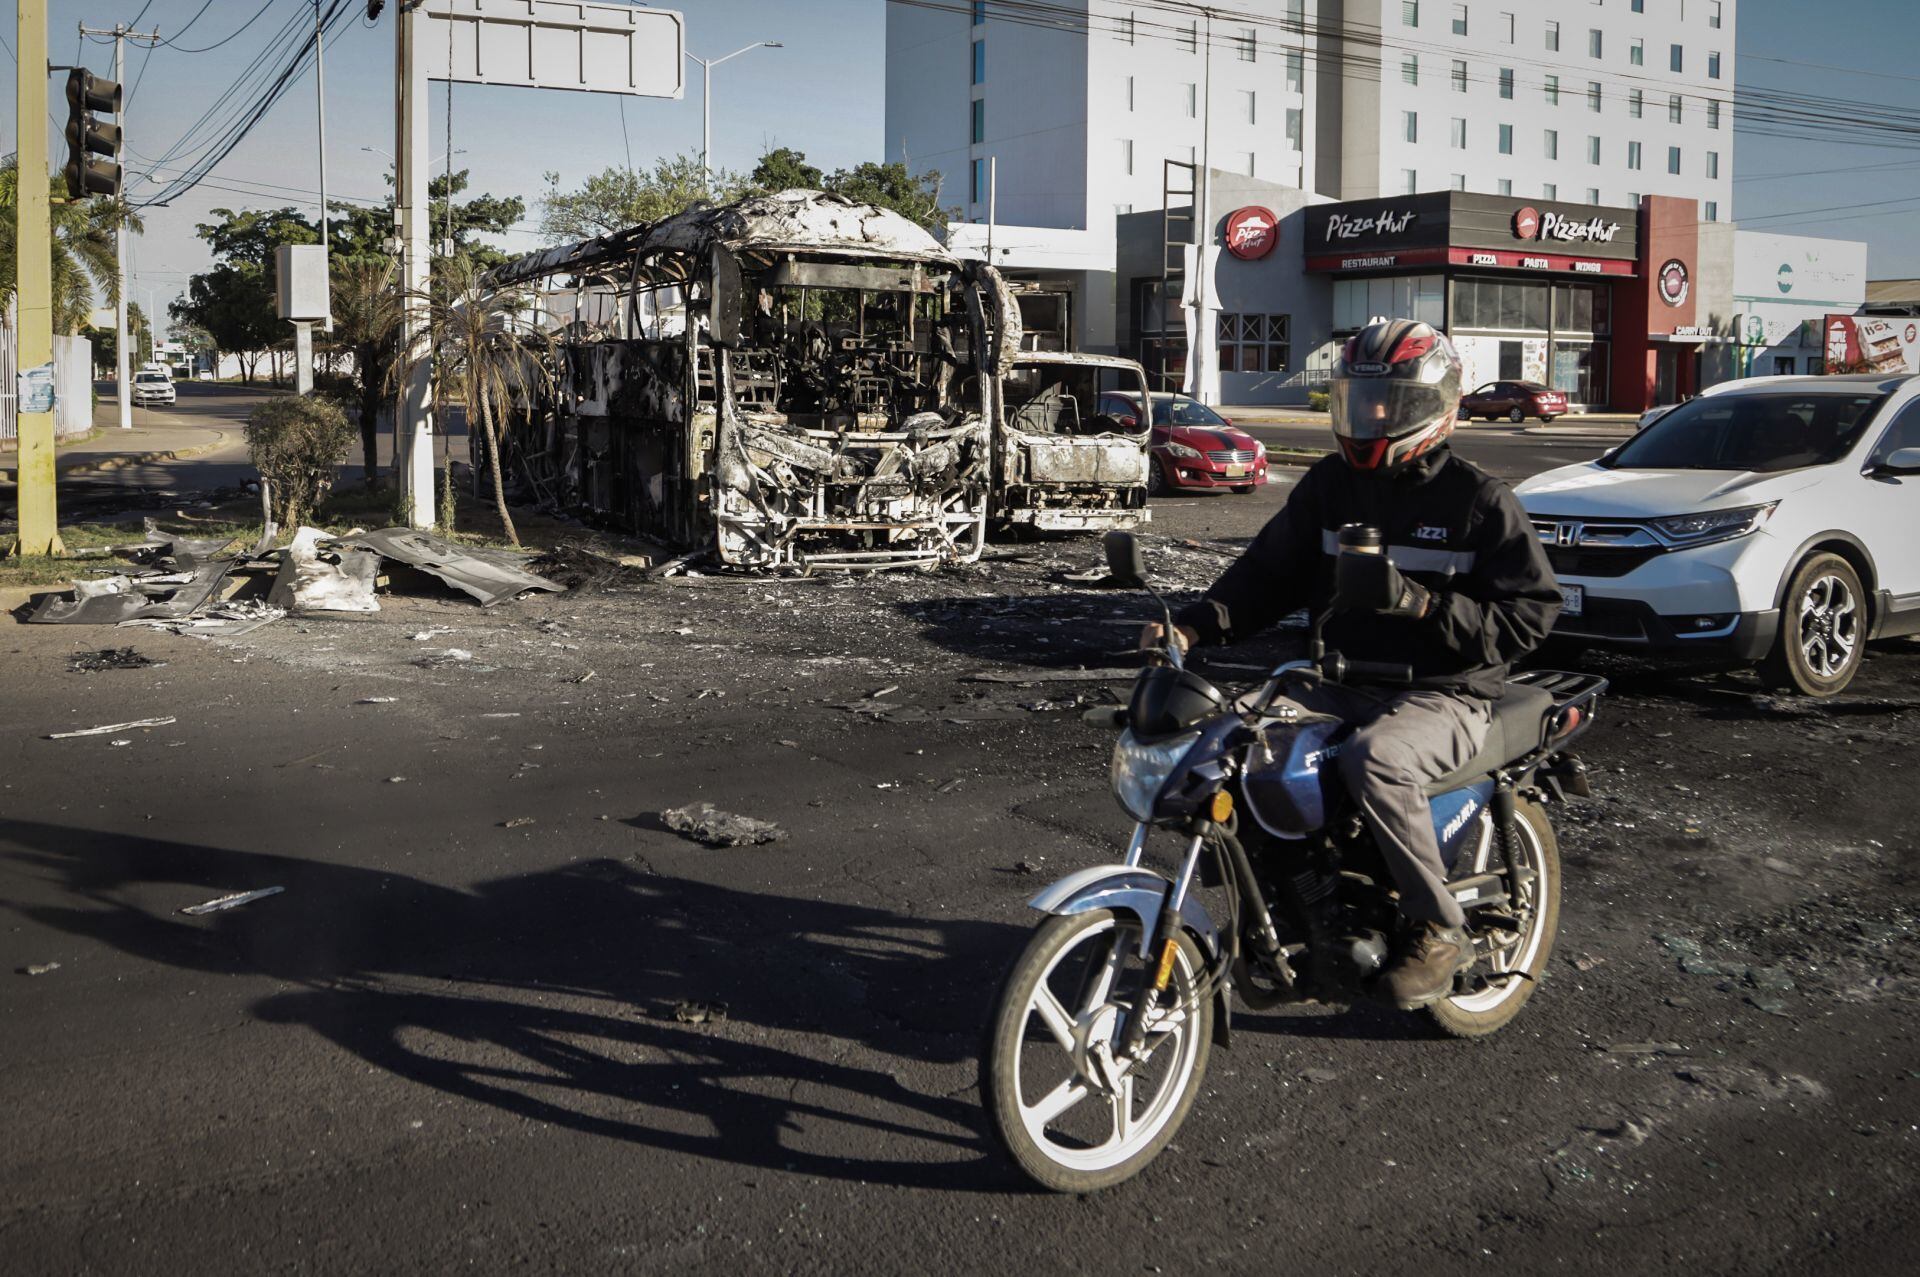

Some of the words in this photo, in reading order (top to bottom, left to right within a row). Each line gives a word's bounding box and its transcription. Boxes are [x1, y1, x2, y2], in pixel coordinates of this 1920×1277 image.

[1235, 226, 1267, 242] Pizza
[1326, 213, 1374, 242] Pizza
[1375, 210, 1416, 235] Hut
[1541, 211, 1588, 241] Pizza
[1585, 217, 1621, 242] Hut
[1240, 237, 1265, 250] Hut
[1341, 255, 1396, 269] RESTAURANT
[1473, 253, 1497, 266] PIZZA
[1524, 257, 1549, 269] PASTA
[1575, 261, 1601, 273] WINGS
[1675, 326, 1699, 336] CARRY
[1699, 326, 1713, 336] OUT
